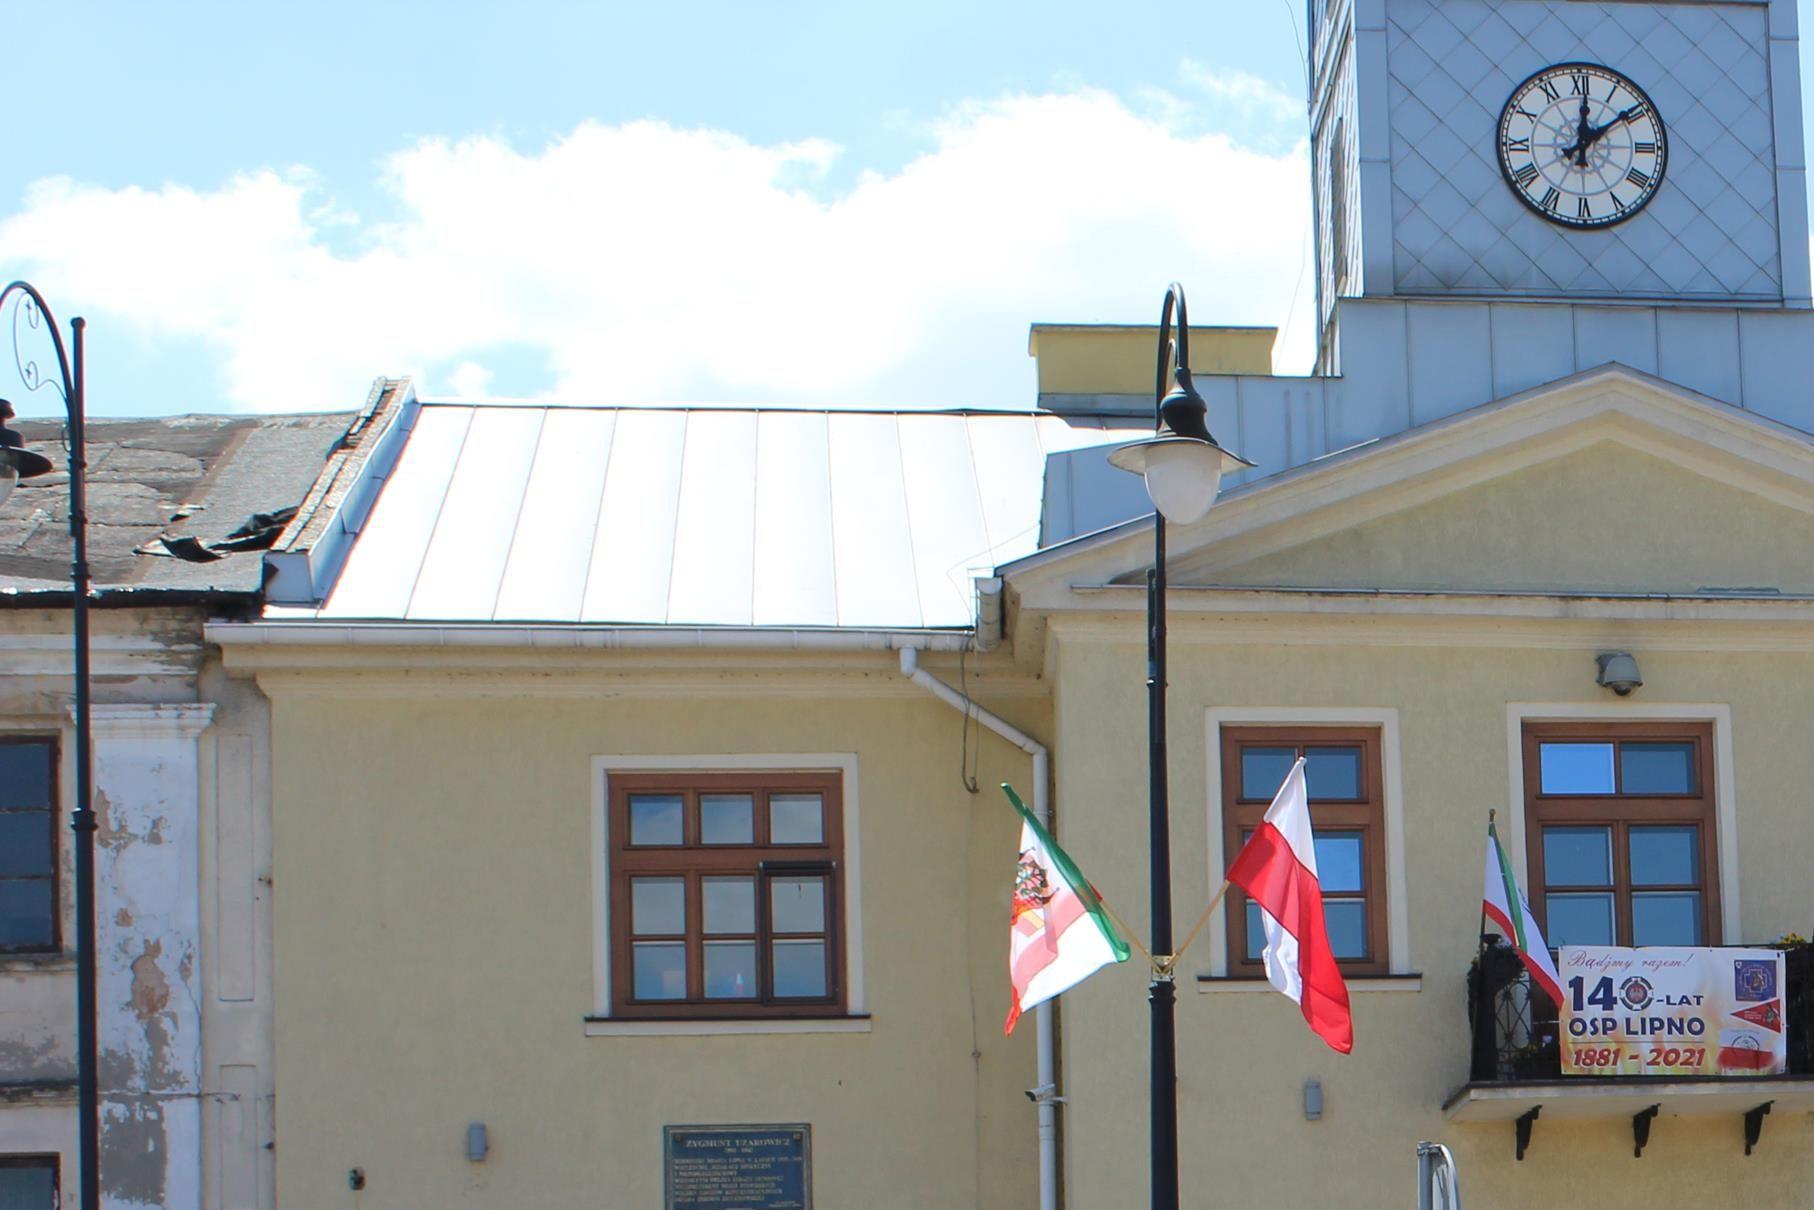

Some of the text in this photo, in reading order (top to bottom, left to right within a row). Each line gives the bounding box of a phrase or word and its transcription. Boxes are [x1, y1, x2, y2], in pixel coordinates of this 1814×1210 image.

[1641, 953, 1695, 972] razem!
[1568, 1016, 1705, 1037] OSP LIPNO
[1573, 1048, 1621, 1067] 1881
[1646, 1047, 1706, 1067] 2021
